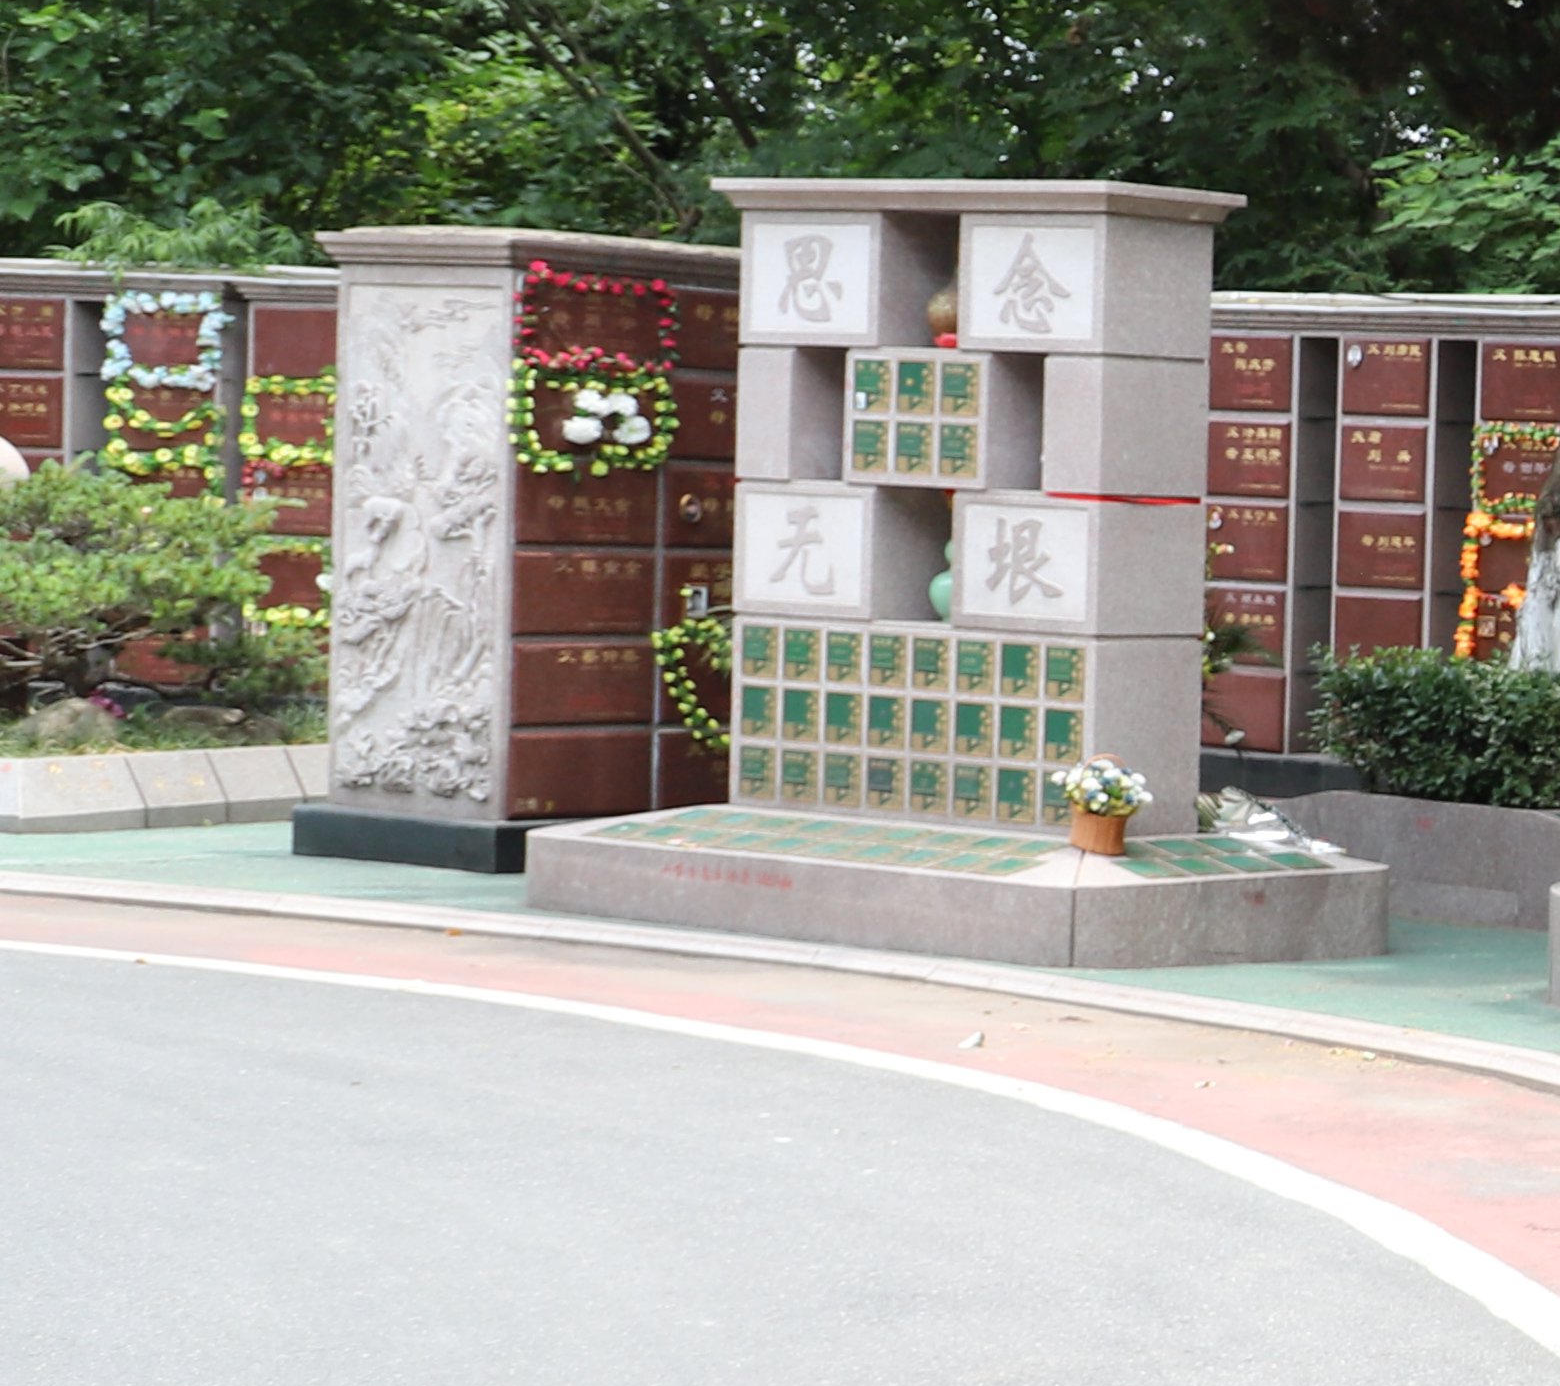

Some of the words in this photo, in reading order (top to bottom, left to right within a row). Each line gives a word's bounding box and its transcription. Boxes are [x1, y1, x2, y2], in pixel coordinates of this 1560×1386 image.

[779, 233, 844, 323] 思
[994, 232, 1071, 335] 念
[769, 504, 835, 597] 无
